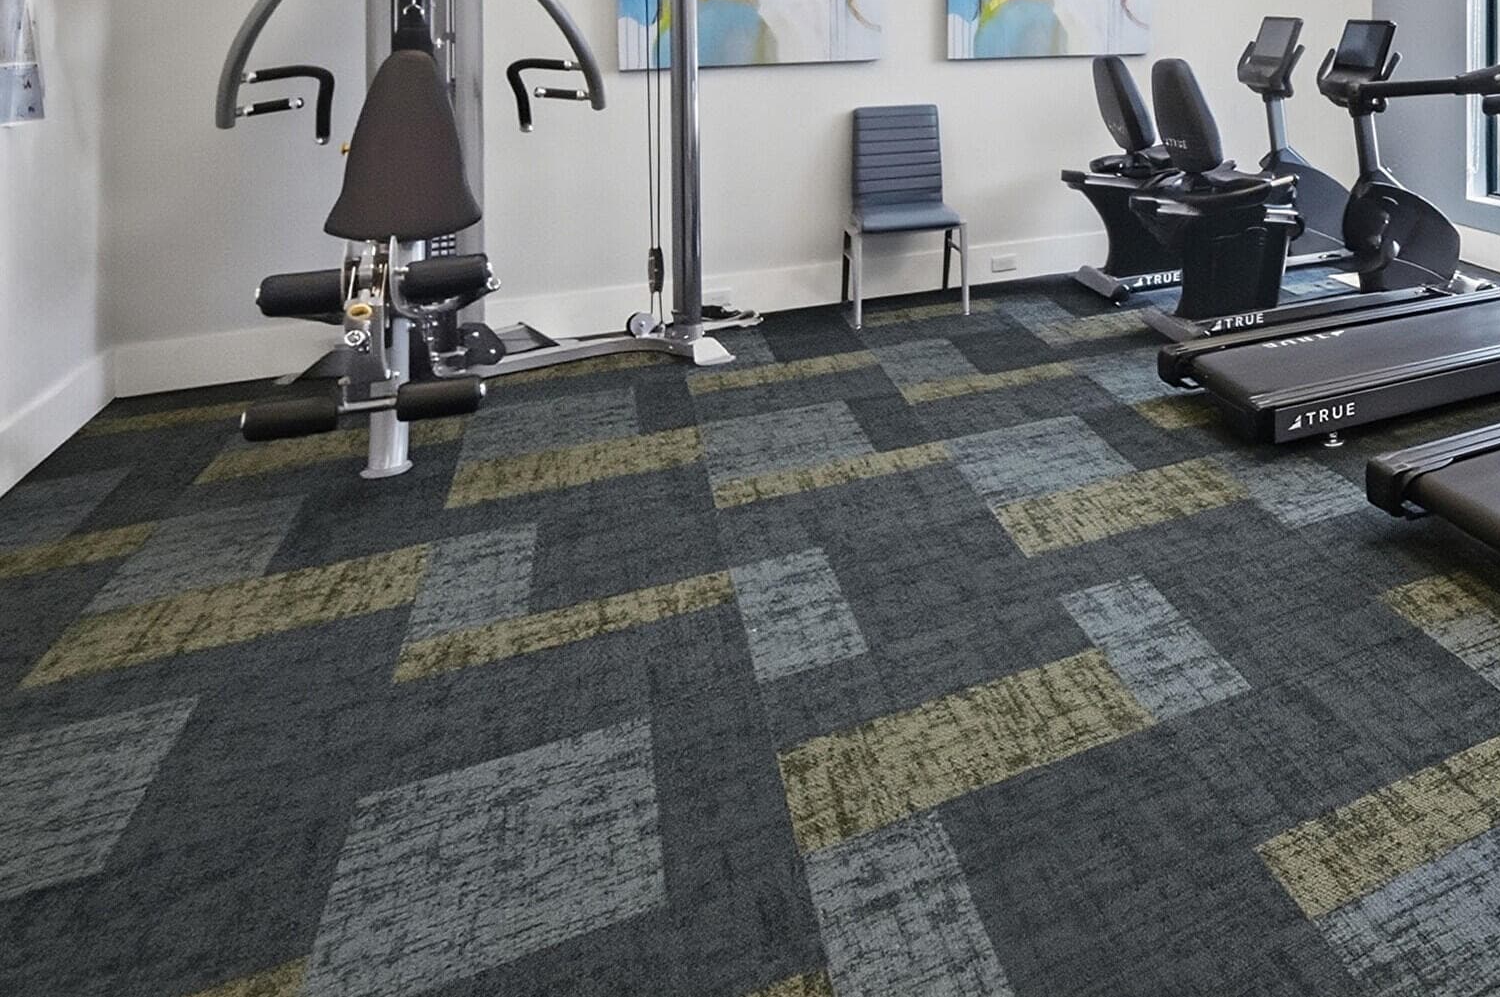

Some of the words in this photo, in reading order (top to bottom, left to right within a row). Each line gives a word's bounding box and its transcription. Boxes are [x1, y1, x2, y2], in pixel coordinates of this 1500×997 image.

[1145, 271, 1182, 285] TRUE
[1224, 313, 1264, 329] TRUE
[1305, 402, 1356, 425] TRUE
